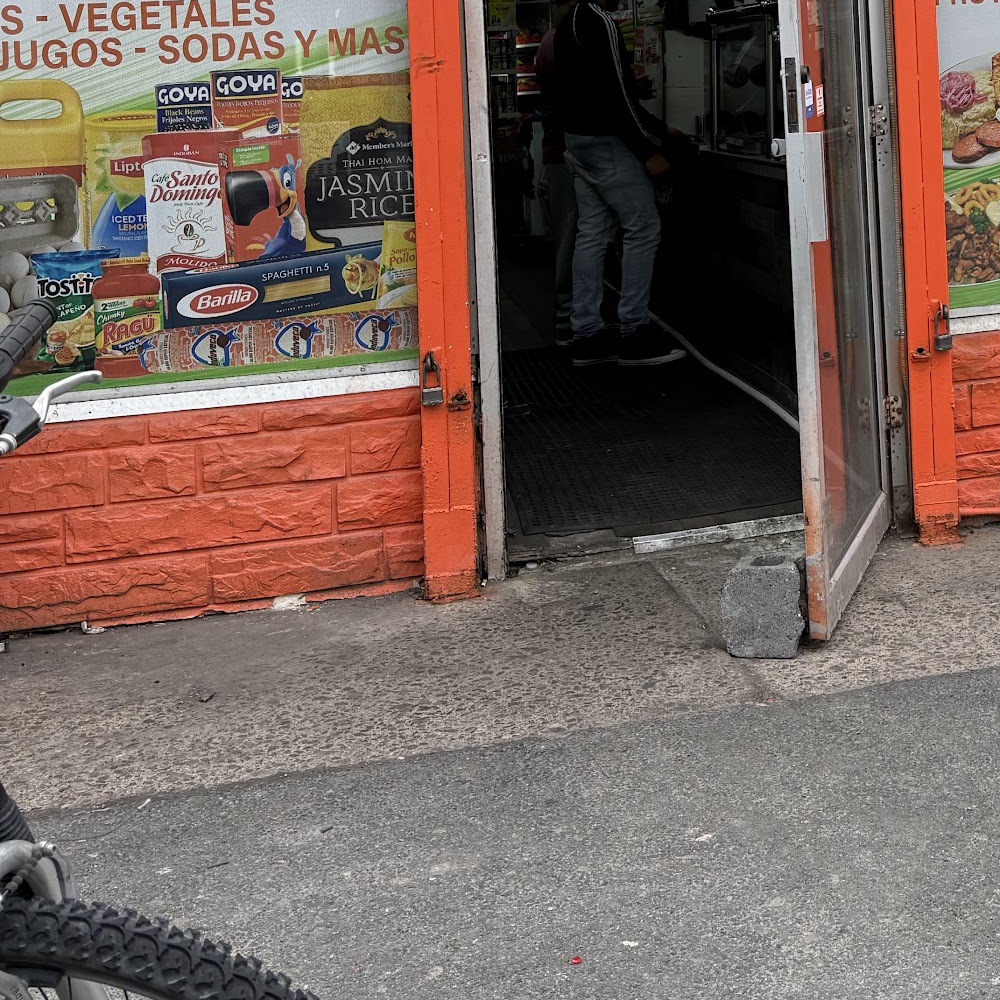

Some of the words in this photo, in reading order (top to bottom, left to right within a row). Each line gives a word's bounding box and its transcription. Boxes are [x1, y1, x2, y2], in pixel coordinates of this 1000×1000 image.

[0, 36, 123, 72] JUGOS
[158, 30, 285, 65] SODAS
[294, 29, 318, 59] Y
[328, 26, 405, 57] MAS
[216, 73, 277, 96] GOYA
[281, 82, 303, 98] GO
[158, 86, 210, 105] GOYA
[161, 116, 186, 124] Frijoles
[186, 115, 208, 124] Negros
[164, 109, 183, 117] Black
[184, 108, 205, 116] Beans
[362, 142, 395, 151] Member's
[114, 161, 145, 174] Lipt
[341, 158, 365, 168] THAI
[368, 156, 392, 166] HOM
[396, 155, 413, 163] MA
[151, 173, 170, 184] Café
[166, 169, 219, 189] Santo
[316, 170, 415, 202] JASMI
[349, 193, 415, 219] RICE
[111, 215, 136, 224] ICED
[136, 214, 147, 222] TE
[391, 248, 408, 256] Sopa
[165, 256, 217, 268] MOLIDO
[389, 253, 416, 267] Pollo
[261, 265, 313, 282] SPAGHETTI
[316, 262, 330, 273] n.5
[37, 272, 101, 298] TOSTIT
[101, 303, 108, 311] 2
[196, 288, 252, 311] Barilla
[58, 304, 87, 318] APEÑO
[96, 309, 126, 326] Chunky
